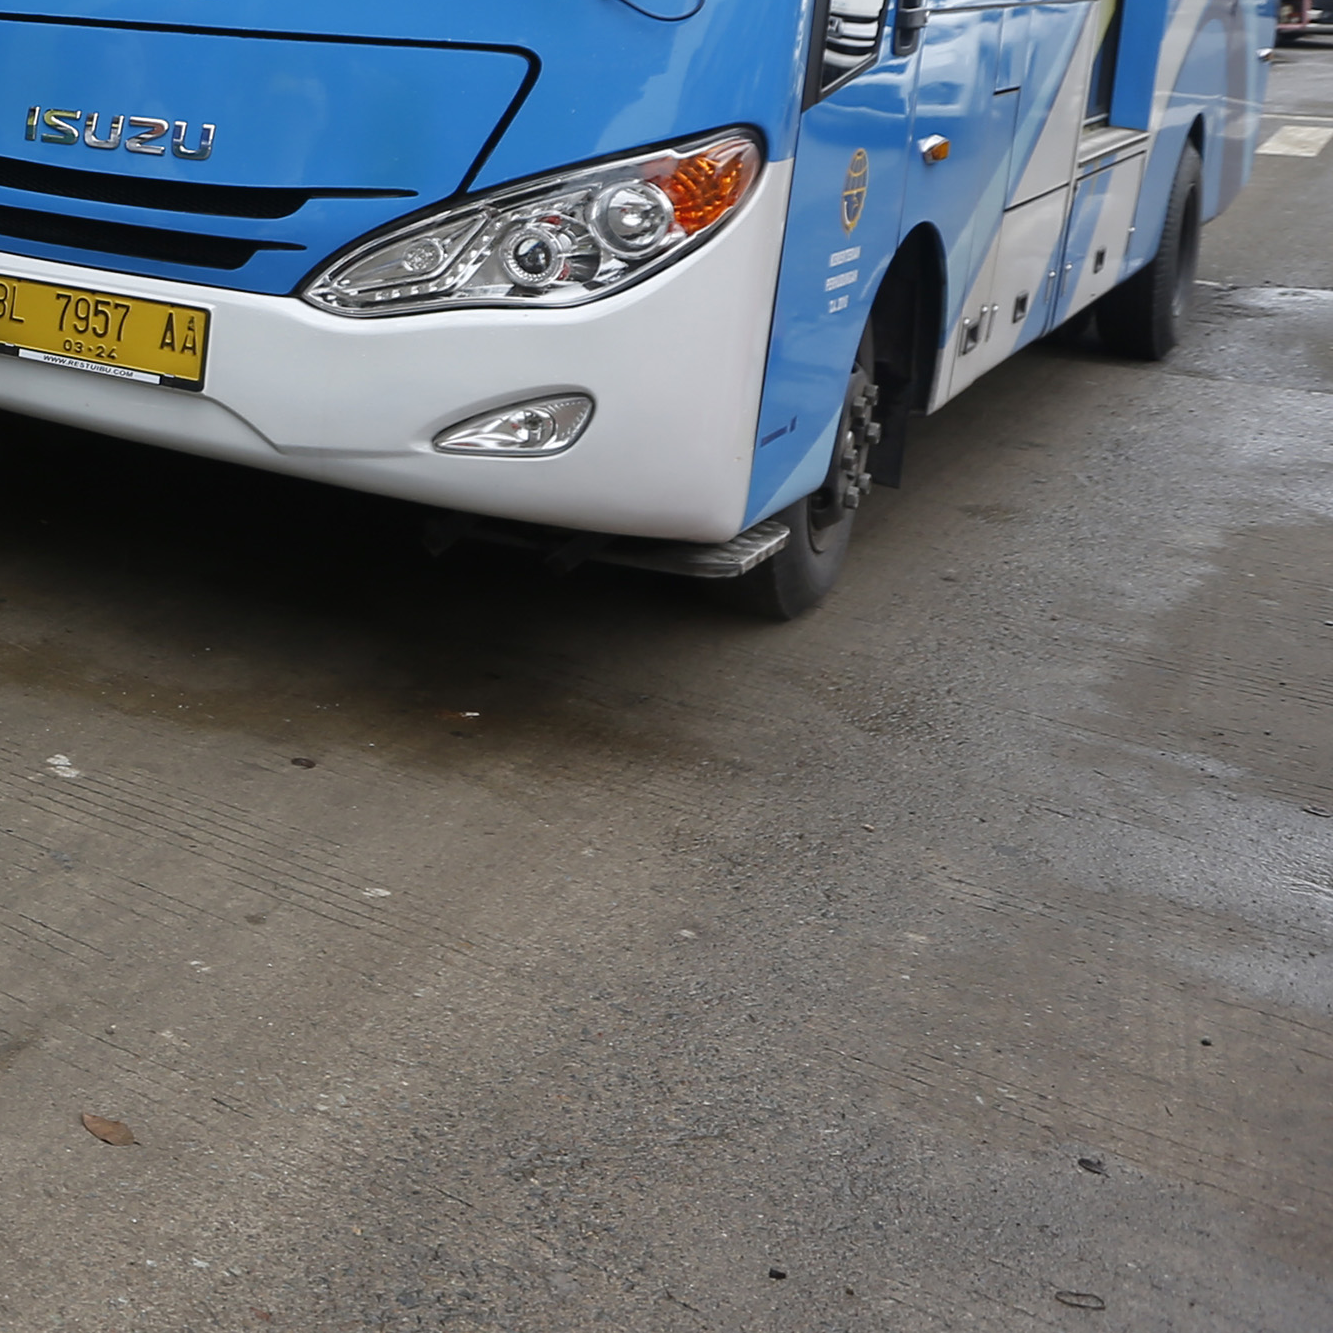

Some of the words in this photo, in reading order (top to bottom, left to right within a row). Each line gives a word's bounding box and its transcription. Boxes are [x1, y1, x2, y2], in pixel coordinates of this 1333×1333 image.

[25, 105, 216, 160] ISUZU
[55, 291, 131, 342] 7957
[159, 310, 198, 356] AA
[43, 354, 134, 378] WWW.RESTUIBU.COM
